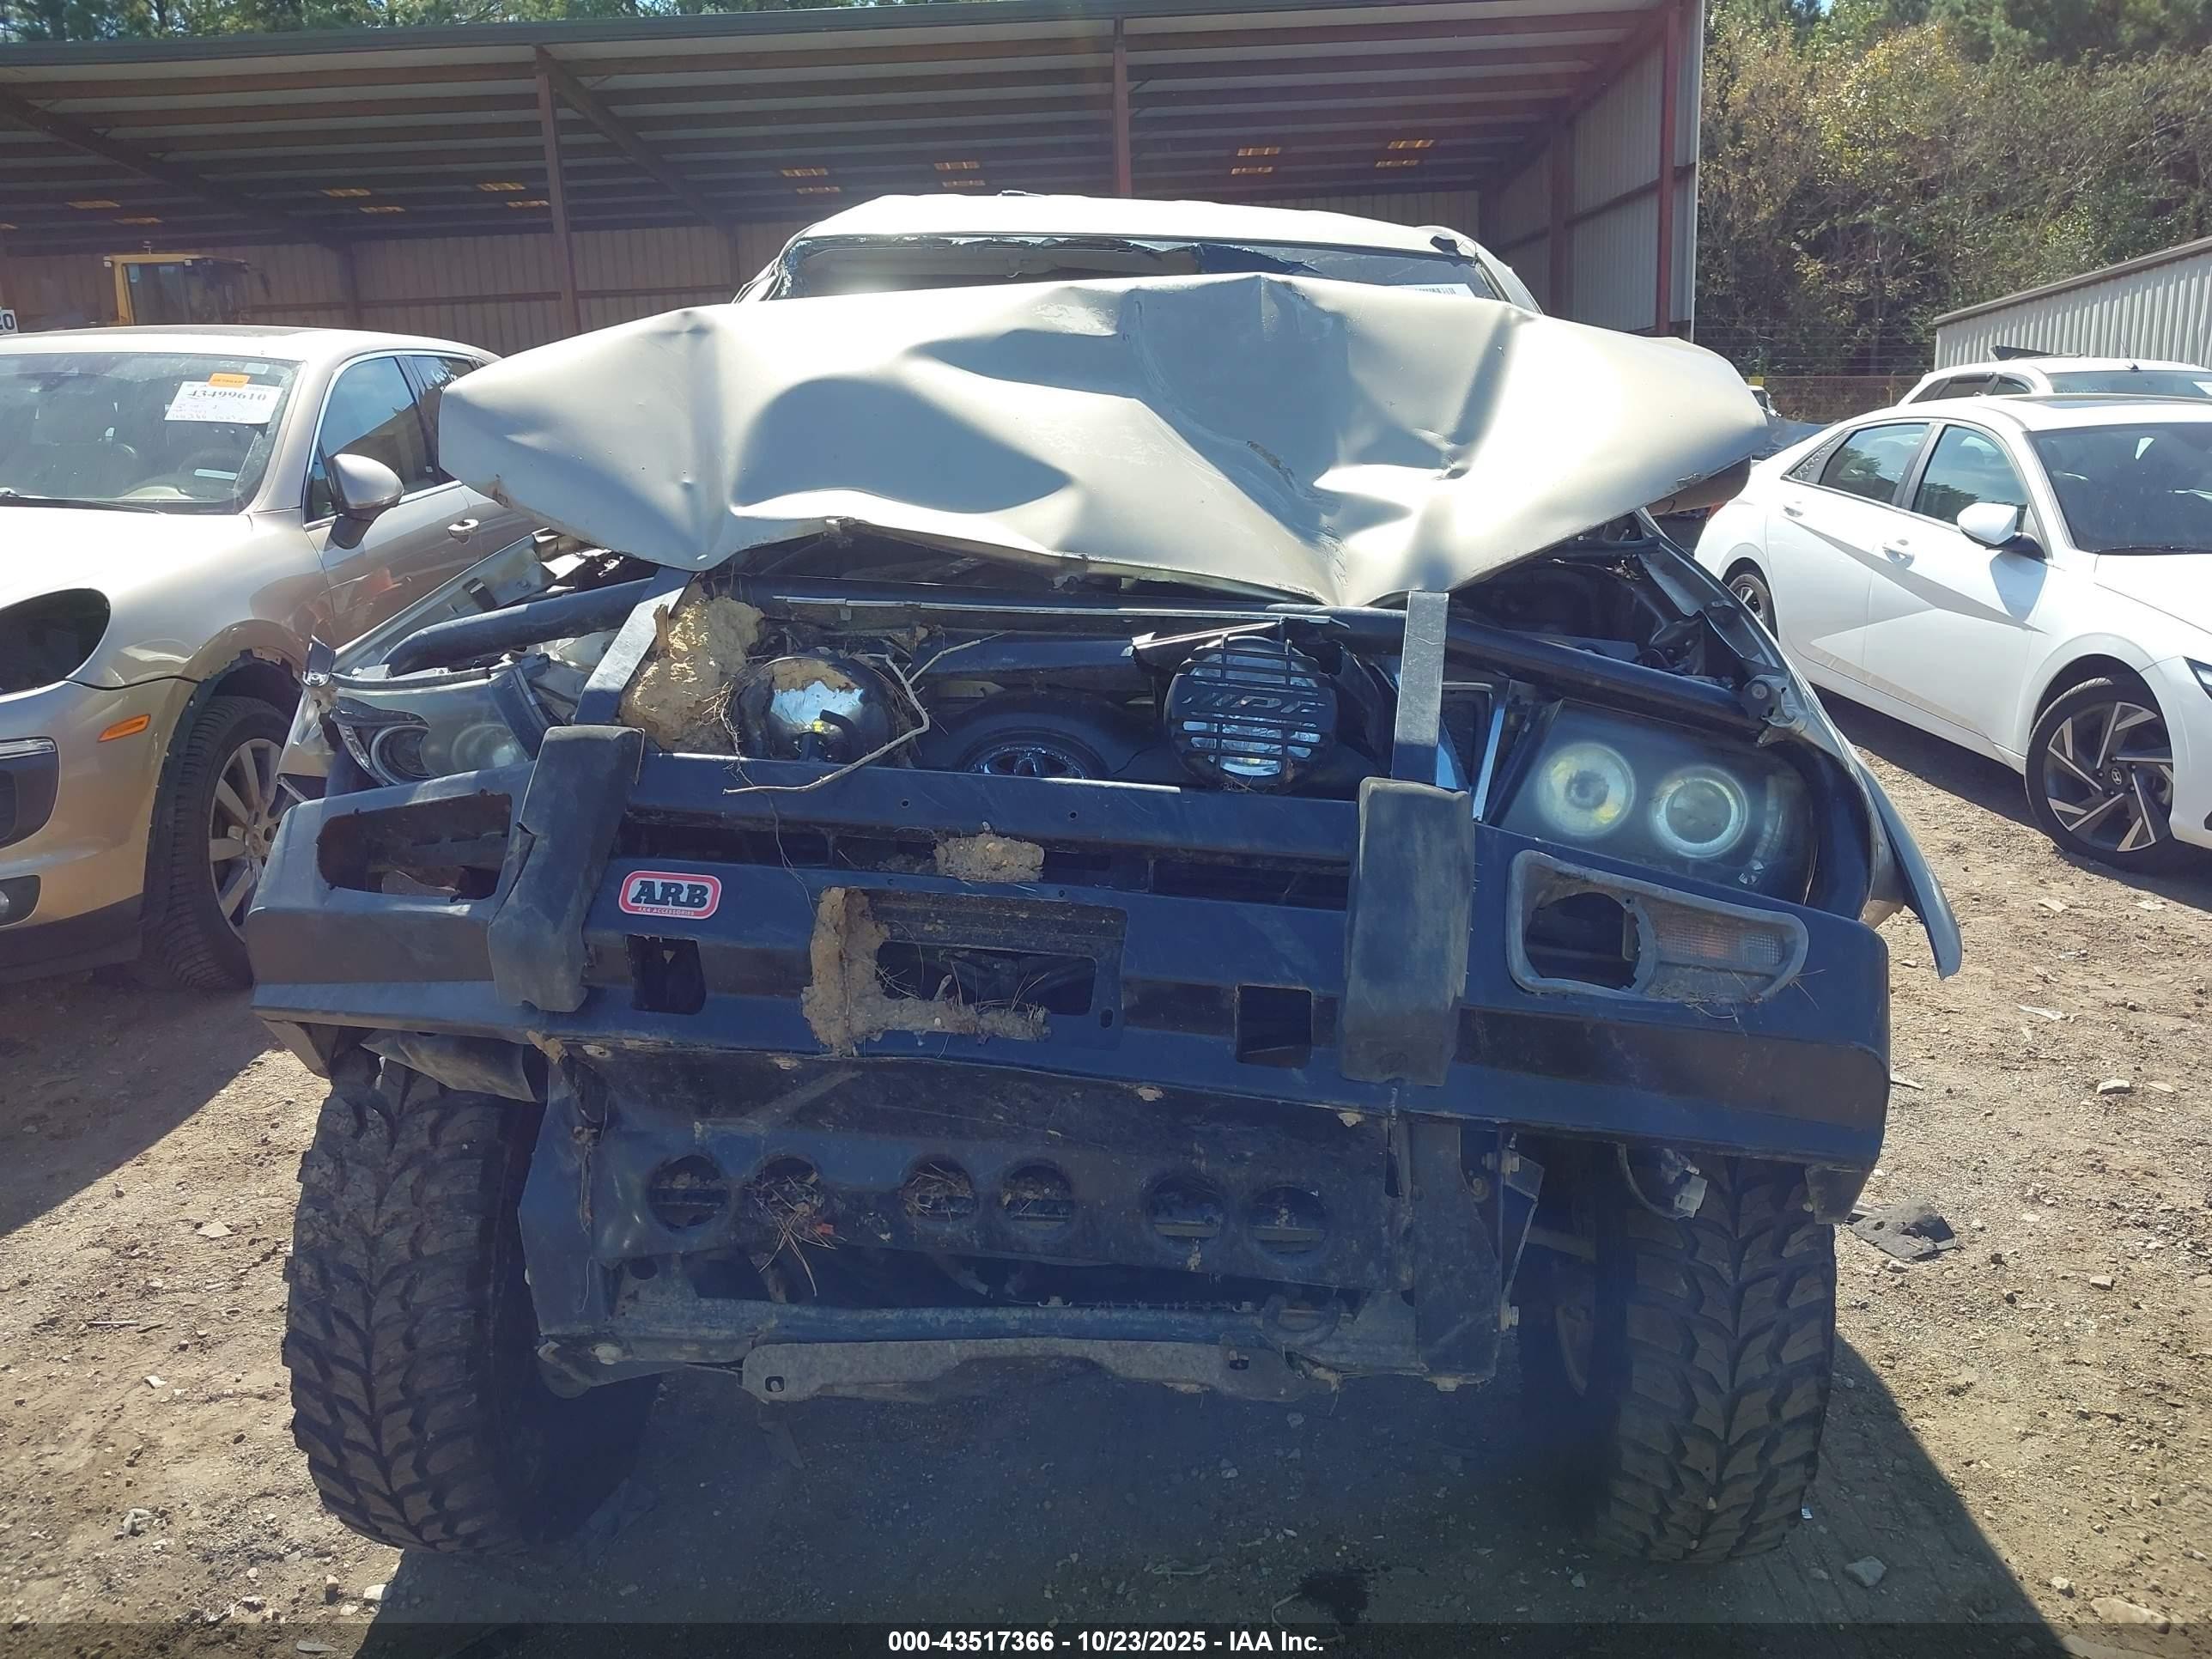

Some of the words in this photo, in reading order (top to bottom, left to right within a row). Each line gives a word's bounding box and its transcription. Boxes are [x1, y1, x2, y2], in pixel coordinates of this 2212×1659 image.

[0, 313, 15, 331] 0
[630, 880, 709, 908] ARB
[653, 908, 695, 916] ACCESSORIES
